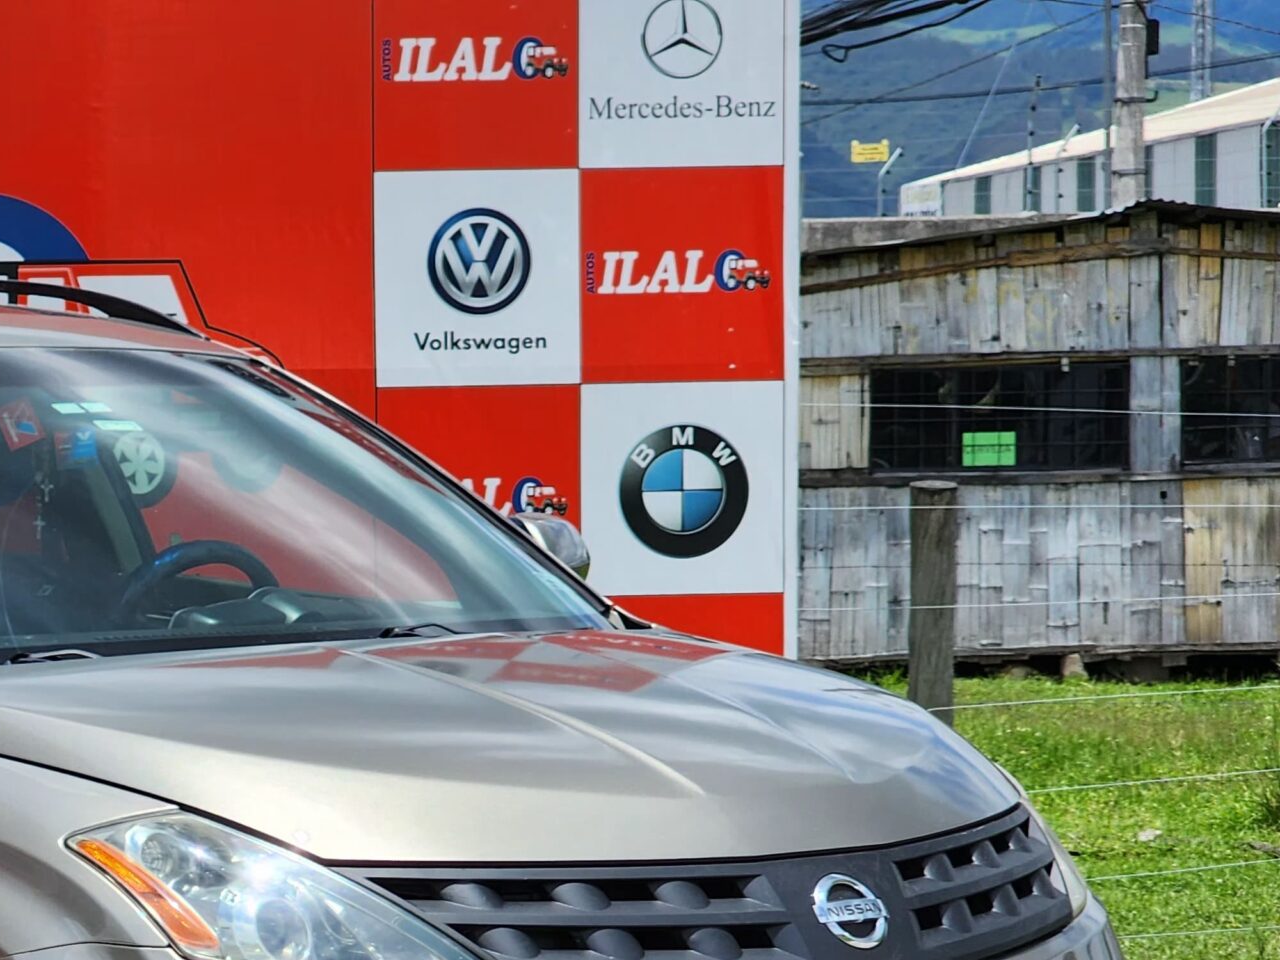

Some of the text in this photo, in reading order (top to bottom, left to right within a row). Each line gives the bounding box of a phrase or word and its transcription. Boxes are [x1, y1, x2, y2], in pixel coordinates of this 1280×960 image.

[382, 39, 392, 81] AUTOS
[588, 95, 776, 120] Mercedes-Benz
[586, 252, 595, 294] AUTOS
[414, 332, 548, 354] Volkswagen
[630, 426, 737, 469] BMW
[826, 902, 882, 917] NISSAN
